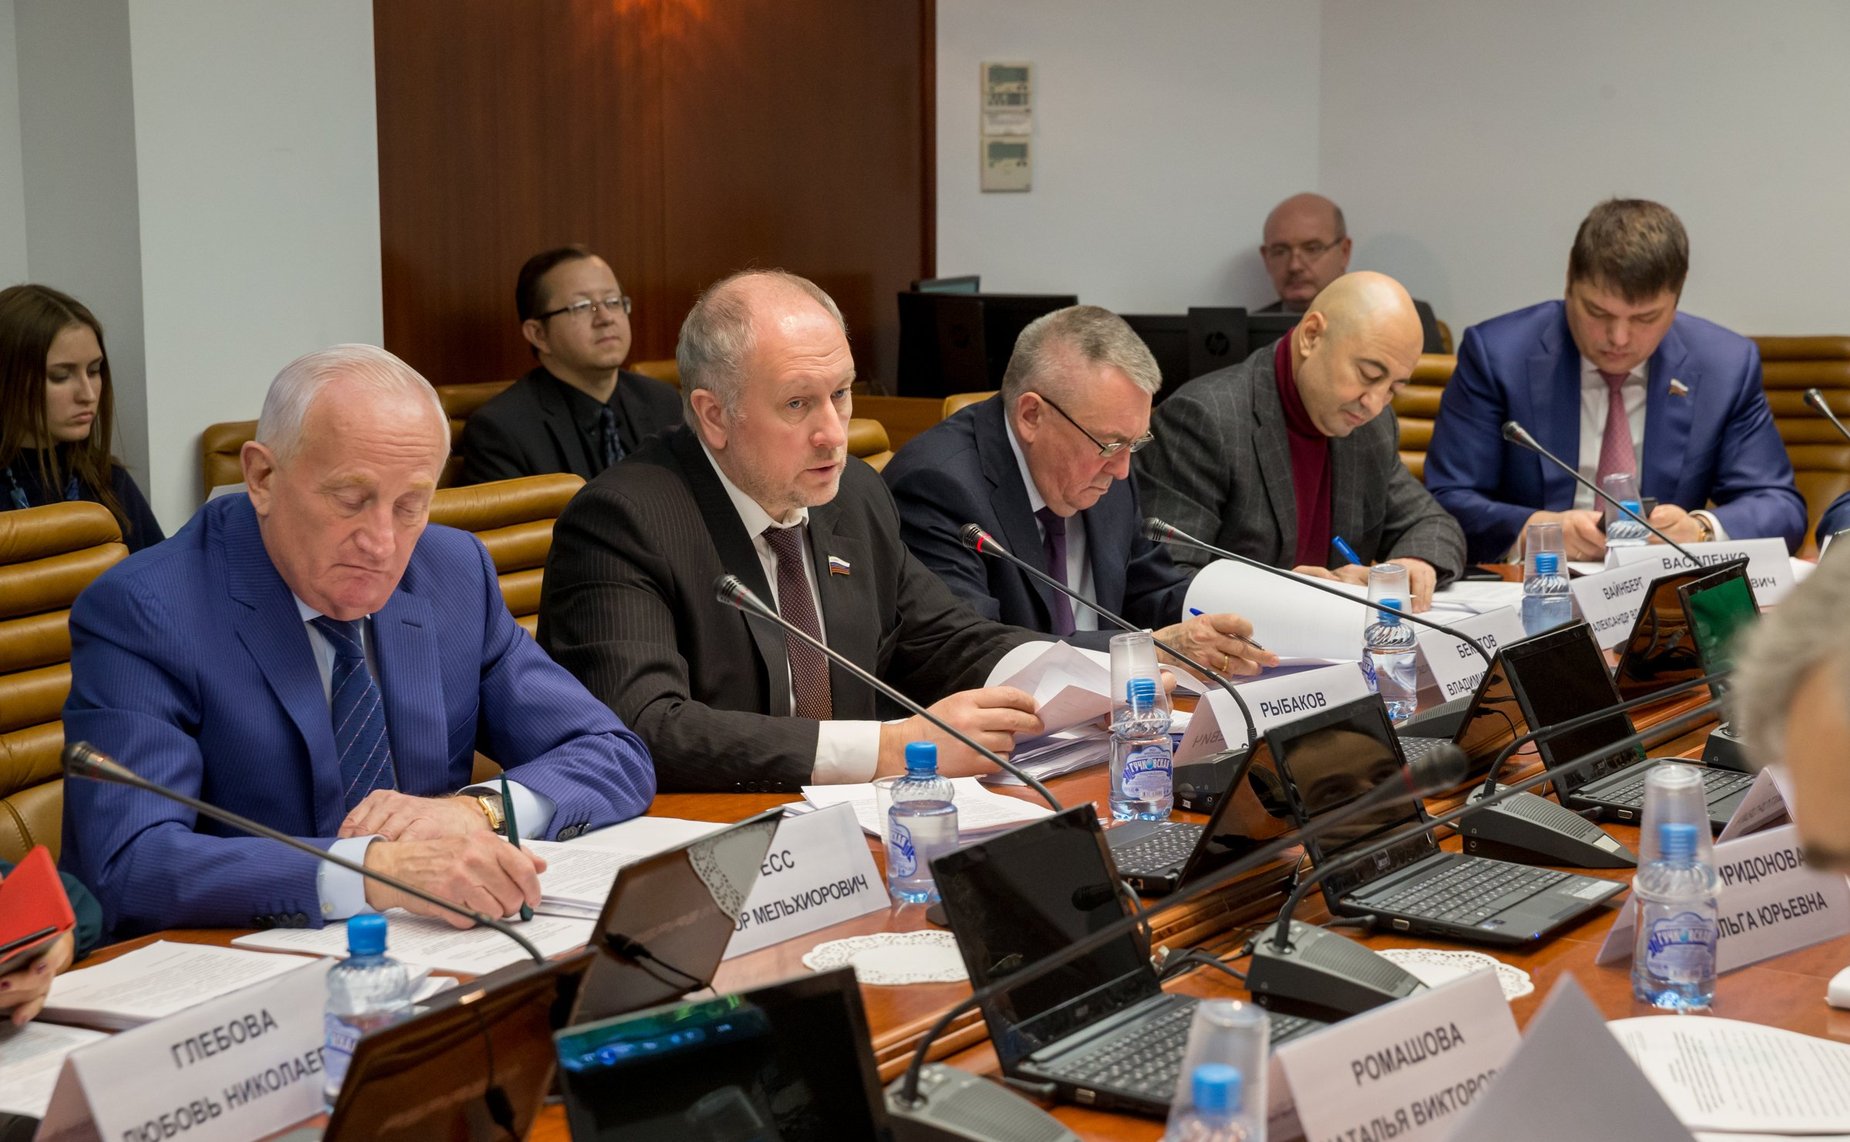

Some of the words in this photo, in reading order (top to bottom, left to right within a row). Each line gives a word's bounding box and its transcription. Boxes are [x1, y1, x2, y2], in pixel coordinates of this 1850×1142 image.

[1602, 576, 1645, 600] ВАЙНБЕРГ
[1750, 577, 1776, 589] ВИЧ
[1455, 634, 1497, 658] БЕКТОВ
[1446, 671, 1486, 696] ВЛАДИМИ
[1260, 691, 1327, 718] РЫБАКОВ
[760, 850, 795, 877] ЕСС
[752, 874, 869, 926] МЕЛЬХИОРОВИЧ
[1756, 890, 1828, 927] ЮРЬЕВНА
[170, 1008, 279, 1069] ГЛЕБОВА
[1351, 1022, 1466, 1086] РОМАШОВА
[1325, 1107, 1411, 1142] ТАЛЬЯ
[1410, 1068, 1496, 1126] ВИКТОРО
